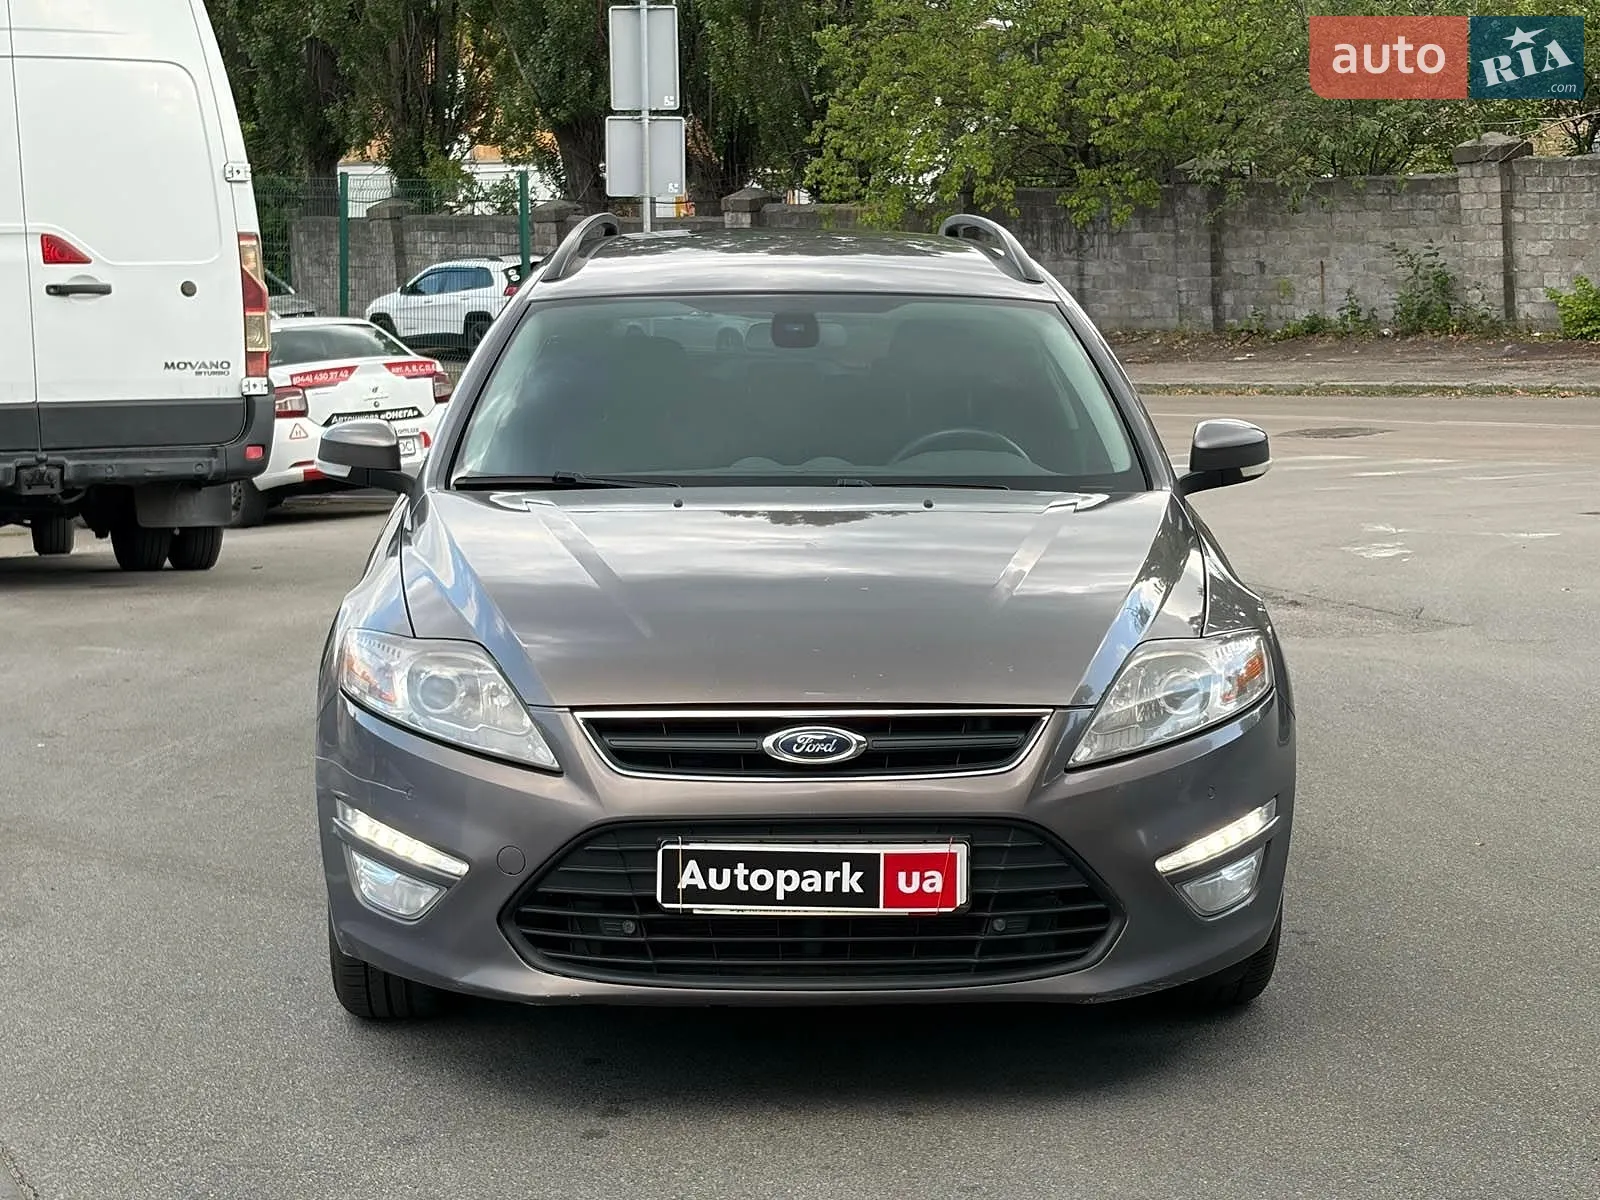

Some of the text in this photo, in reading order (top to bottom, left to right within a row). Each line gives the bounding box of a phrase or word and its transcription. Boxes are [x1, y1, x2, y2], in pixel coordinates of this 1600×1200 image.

[163, 360, 231, 370] MOVANO
[792, 734, 837, 755] Ford
[676, 858, 944, 900] Autopark ua
